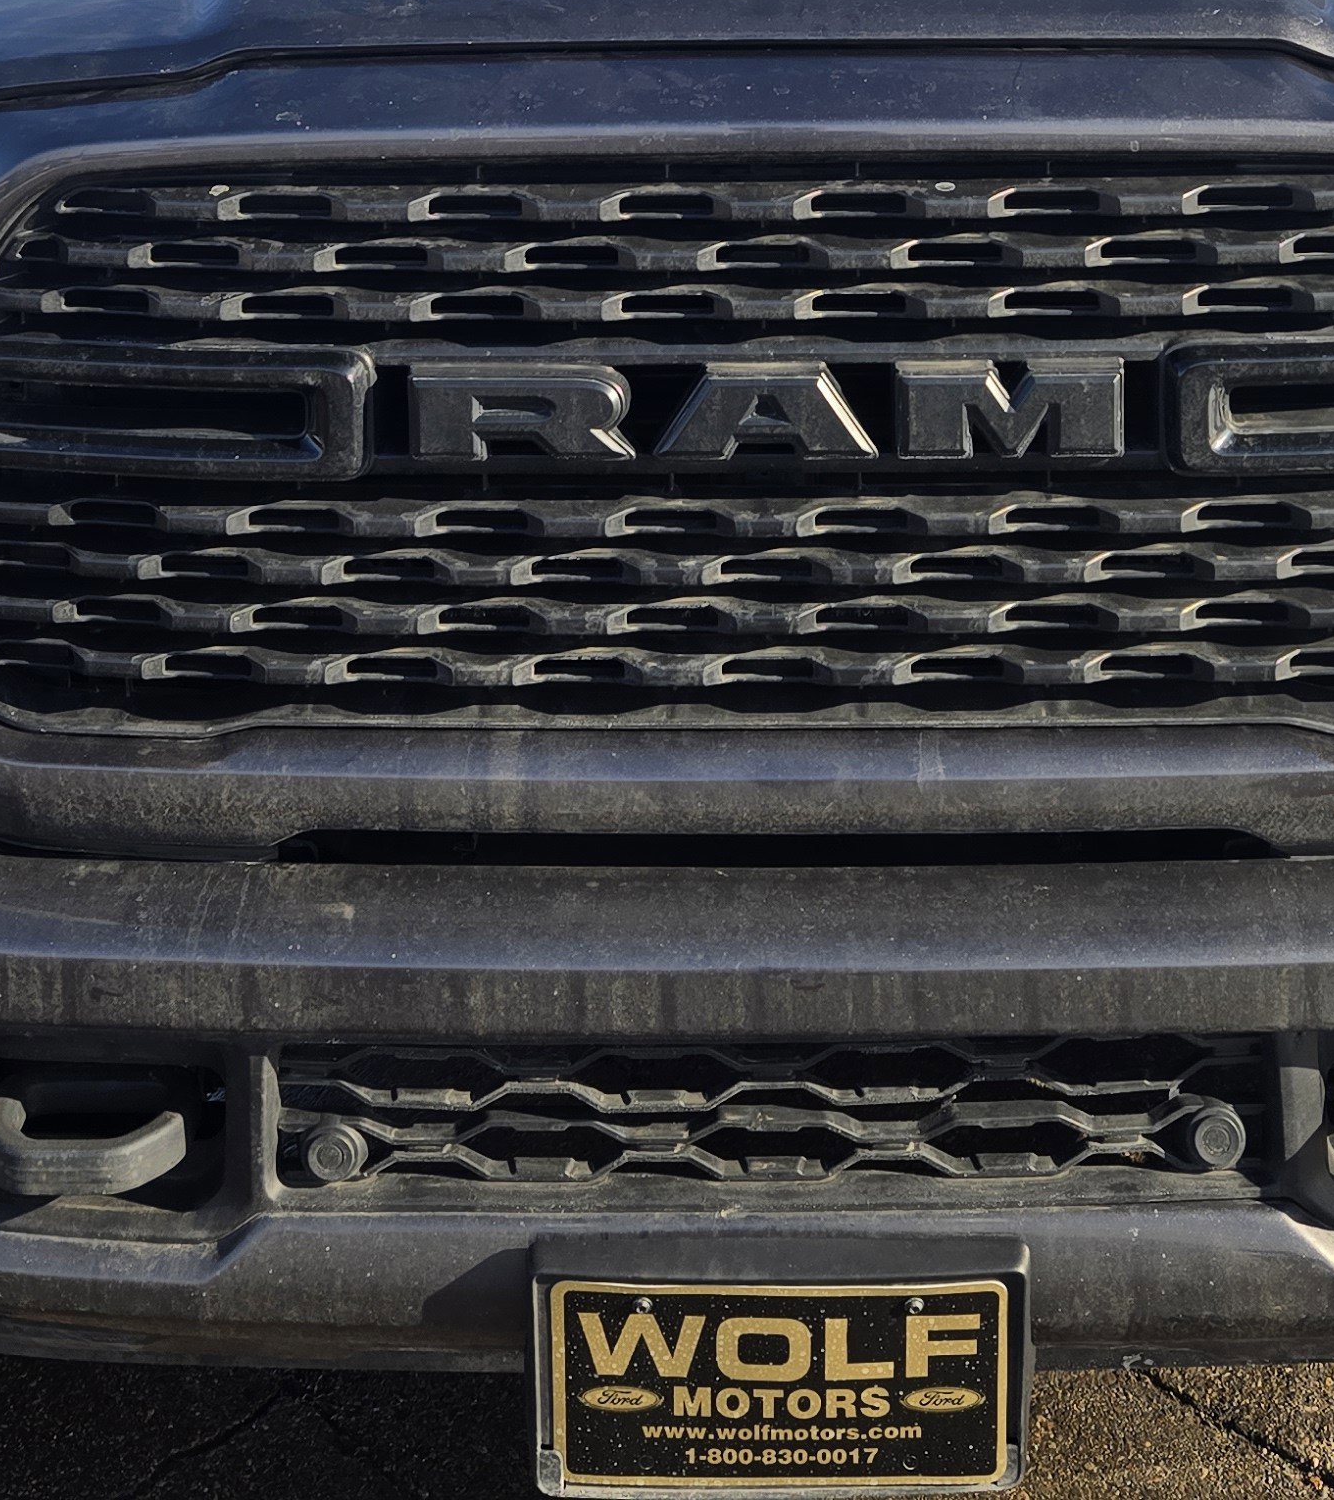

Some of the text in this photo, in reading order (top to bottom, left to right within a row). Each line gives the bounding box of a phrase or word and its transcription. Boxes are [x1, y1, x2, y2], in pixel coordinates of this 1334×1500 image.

[411, 359, 1125, 462] RAM
[577, 1312, 982, 1383] WOLF
[597, 1388, 644, 1409] Ford
[673, 1387, 891, 1420] MOTORS
[917, 1388, 967, 1409] Ford
[641, 1423, 922, 1443] www.wolfmotors.com
[684, 1446, 879, 1466] 1-800-830-0017
